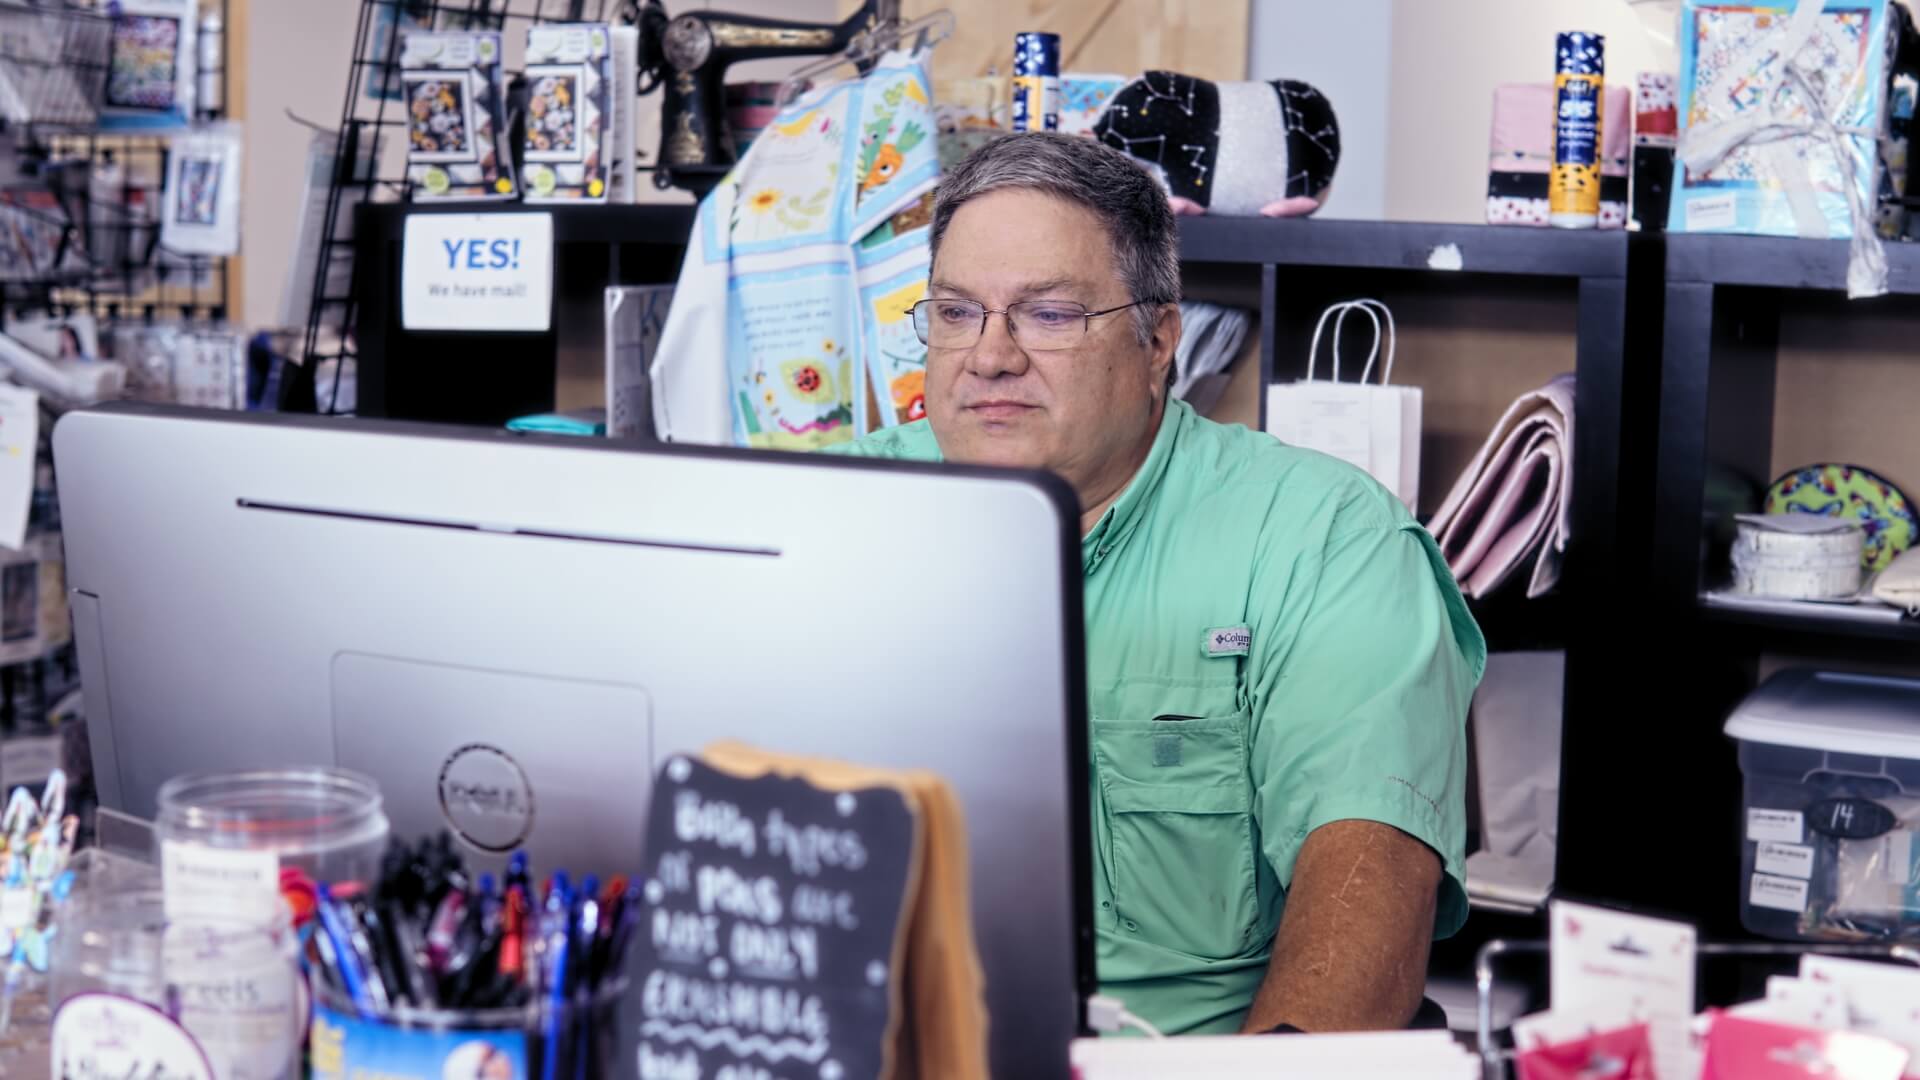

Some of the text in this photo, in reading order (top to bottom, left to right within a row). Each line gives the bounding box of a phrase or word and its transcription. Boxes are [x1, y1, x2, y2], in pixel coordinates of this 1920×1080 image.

[442, 238, 521, 270] YES!
[429, 284, 449, 297] We
[453, 283, 486, 298] have
[1224, 632, 1249, 643] Colum
[1831, 802, 1854, 830] 14
